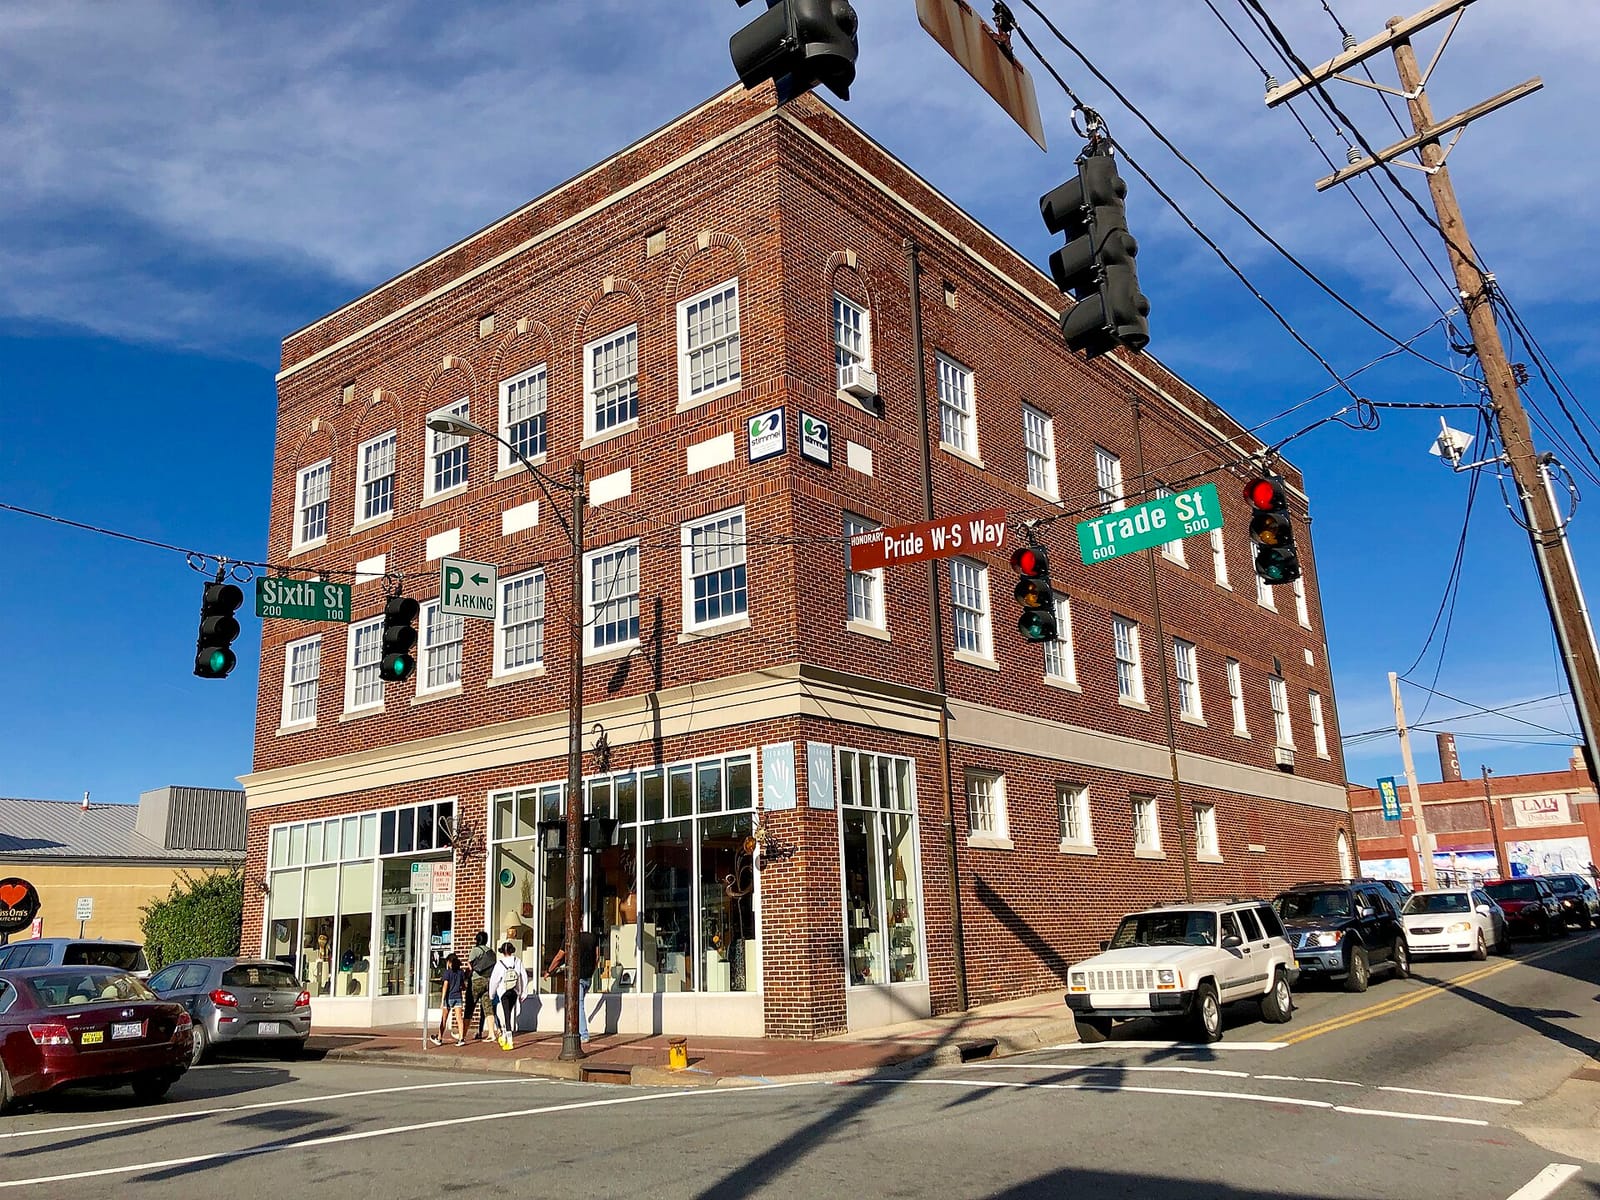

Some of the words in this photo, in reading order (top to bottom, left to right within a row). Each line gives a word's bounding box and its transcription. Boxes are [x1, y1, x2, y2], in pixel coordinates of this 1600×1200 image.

[751, 430, 781, 447] stimmel
[1087, 506, 1168, 546] Trade
[1174, 491, 1206, 522] St
[1184, 517, 1210, 534] 500
[851, 531, 885, 547] HONORARY
[884, 532, 924, 559] Pride
[931, 525, 962, 551] W-S
[969, 519, 1005, 547] Way
[1092, 544, 1116, 560] 600
[263, 580, 316, 607] Sixth
[323, 584, 344, 609] St
[445, 566, 493, 611] PARKING
[262, 605, 282, 616] 200
[326, 609, 344, 620] 100
